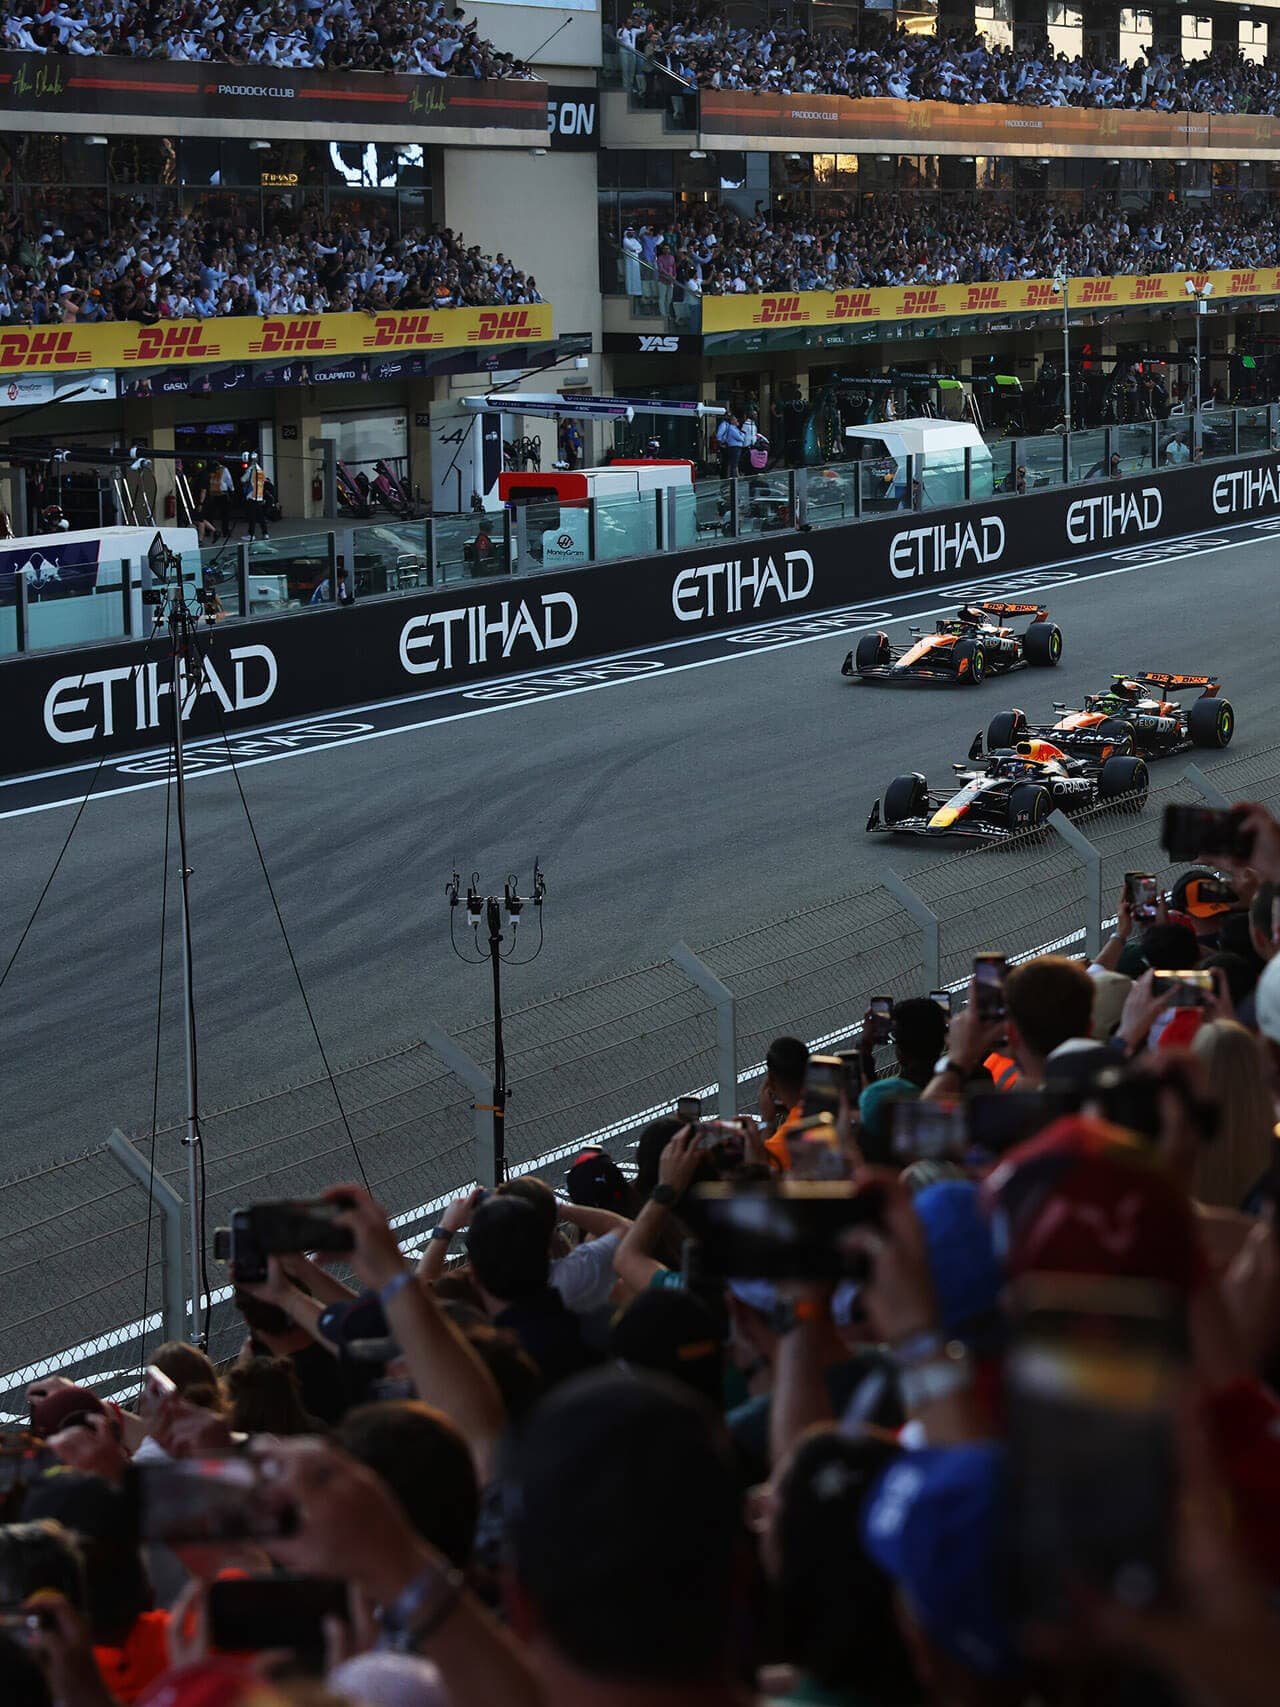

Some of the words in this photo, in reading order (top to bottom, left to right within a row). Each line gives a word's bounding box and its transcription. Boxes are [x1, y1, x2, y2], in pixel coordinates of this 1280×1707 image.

[218, 85, 268, 97] PADDOCK
[269, 88, 295, 97] CLUB
[967, 287, 1001, 310] DHL
[1083, 281, 1114, 302] DHL
[1136, 278, 1163, 299] DHL
[1231, 273, 1257, 293] DHL
[761, 297, 803, 323] DHL
[834, 293, 874, 318] DHL
[903, 290, 940, 314] DHL
[261, 320, 326, 352] DHL
[375, 315, 434, 347] DHL
[479, 310, 533, 341] DHL
[0, 331, 78, 367] DHL
[137, 325, 208, 360] DHL
[638, 335, 680, 352] YAS
[163, 382, 189, 392] GASLY
[314, 370, 356, 381] COLAPINTO
[1065, 486, 1163, 545] ETIHAD
[889, 515, 1006, 580] ETIHAD
[672, 549, 814, 622] ETIHAD
[939, 571, 1078, 599] ETIHAD
[399, 591, 579, 675] ETIHAD
[726, 610, 893, 644] ETIHAD
[43, 644, 278, 745] ETIHAD
[462, 659, 665, 699] ETIHAD
[116, 722, 375, 774] ETIHAD
